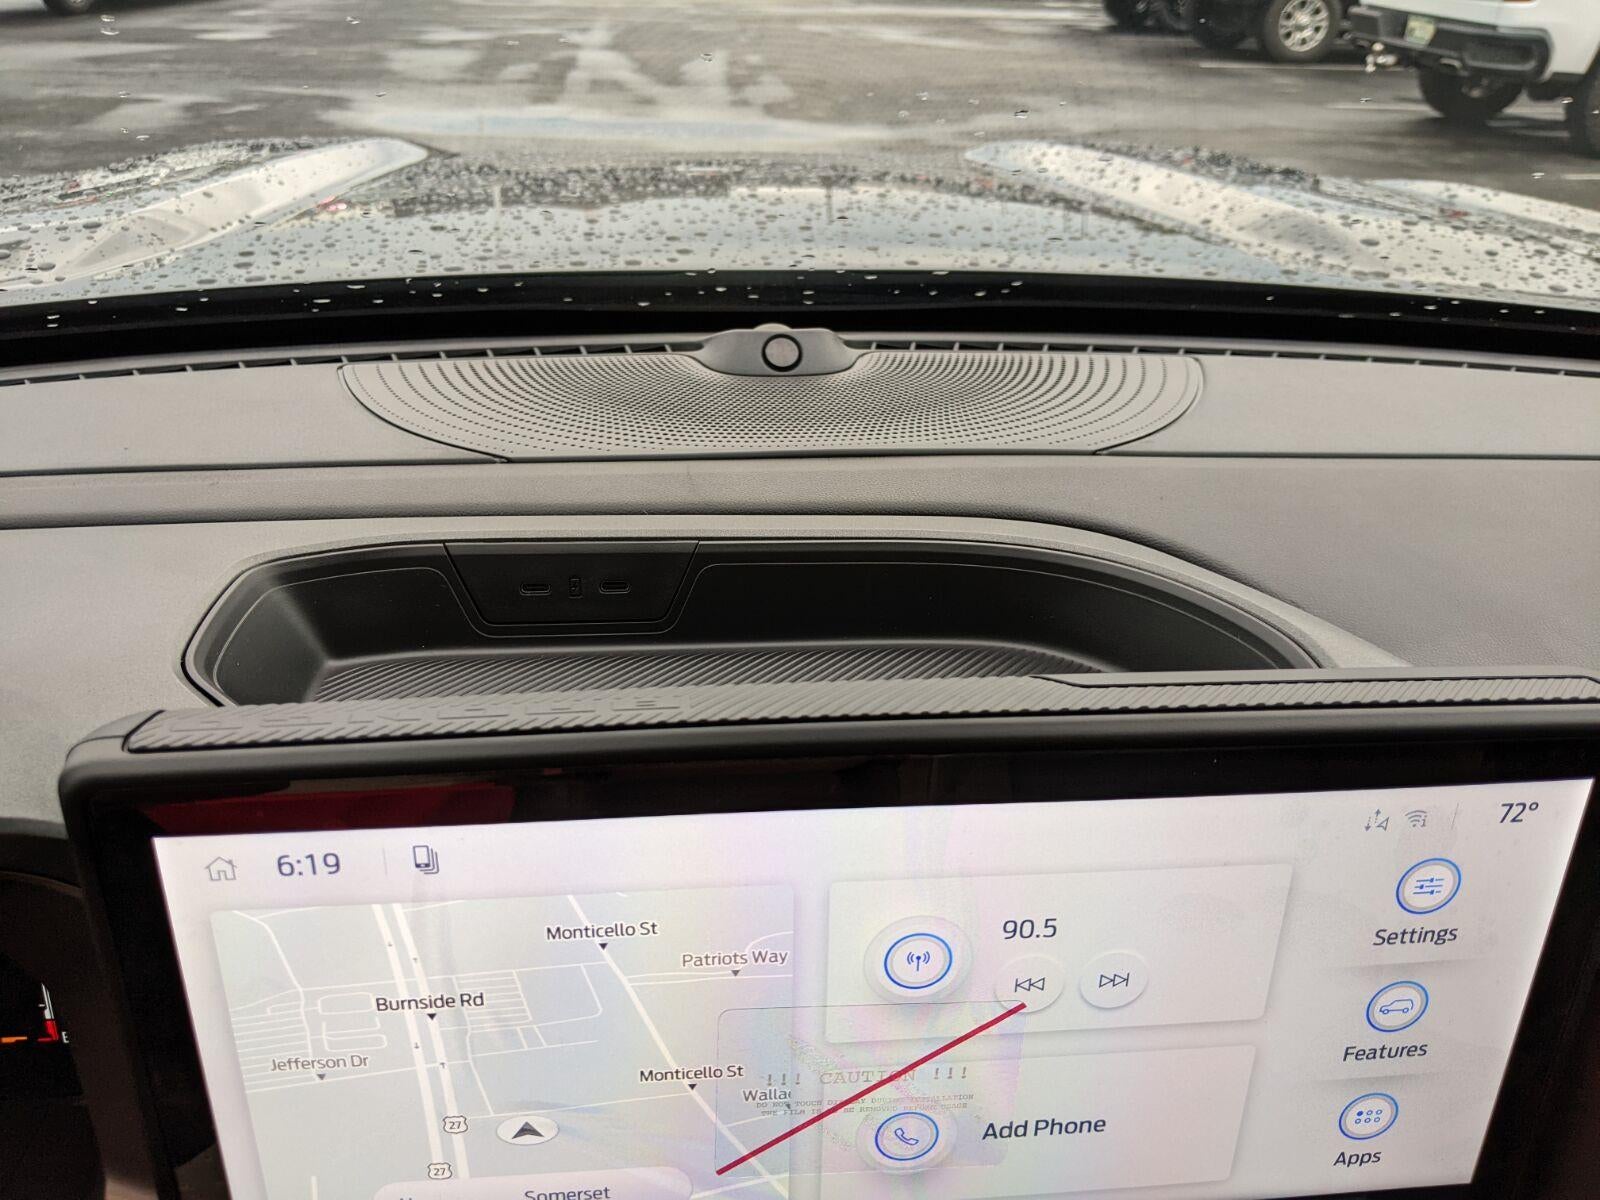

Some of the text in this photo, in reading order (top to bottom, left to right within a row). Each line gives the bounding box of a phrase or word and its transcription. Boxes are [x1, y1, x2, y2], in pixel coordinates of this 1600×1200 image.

[1499, 801, 1539, 825] 72°
[276, 852, 341, 877] 6:19
[546, 921, 658, 941] Monticello St
[1002, 918, 1058, 940] 90.5
[1373, 924, 1459, 947] Settings
[682, 949, 789, 968] Patriots Way
[375, 992, 485, 1012] Burnside Rd
[61, 1031, 70, 1044] E
[1342, 1041, 1429, 1062] Features
[270, 1054, 369, 1072] Jefferson Dr
[639, 1065, 744, 1082] Monticello St
[448, 1120, 462, 1131] 27
[982, 1117, 1107, 1141] Add Phone
[1333, 1149, 1382, 1167] Apps
[433, 1166, 447, 1177] 27
[524, 1186, 612, 1200] Somerset
